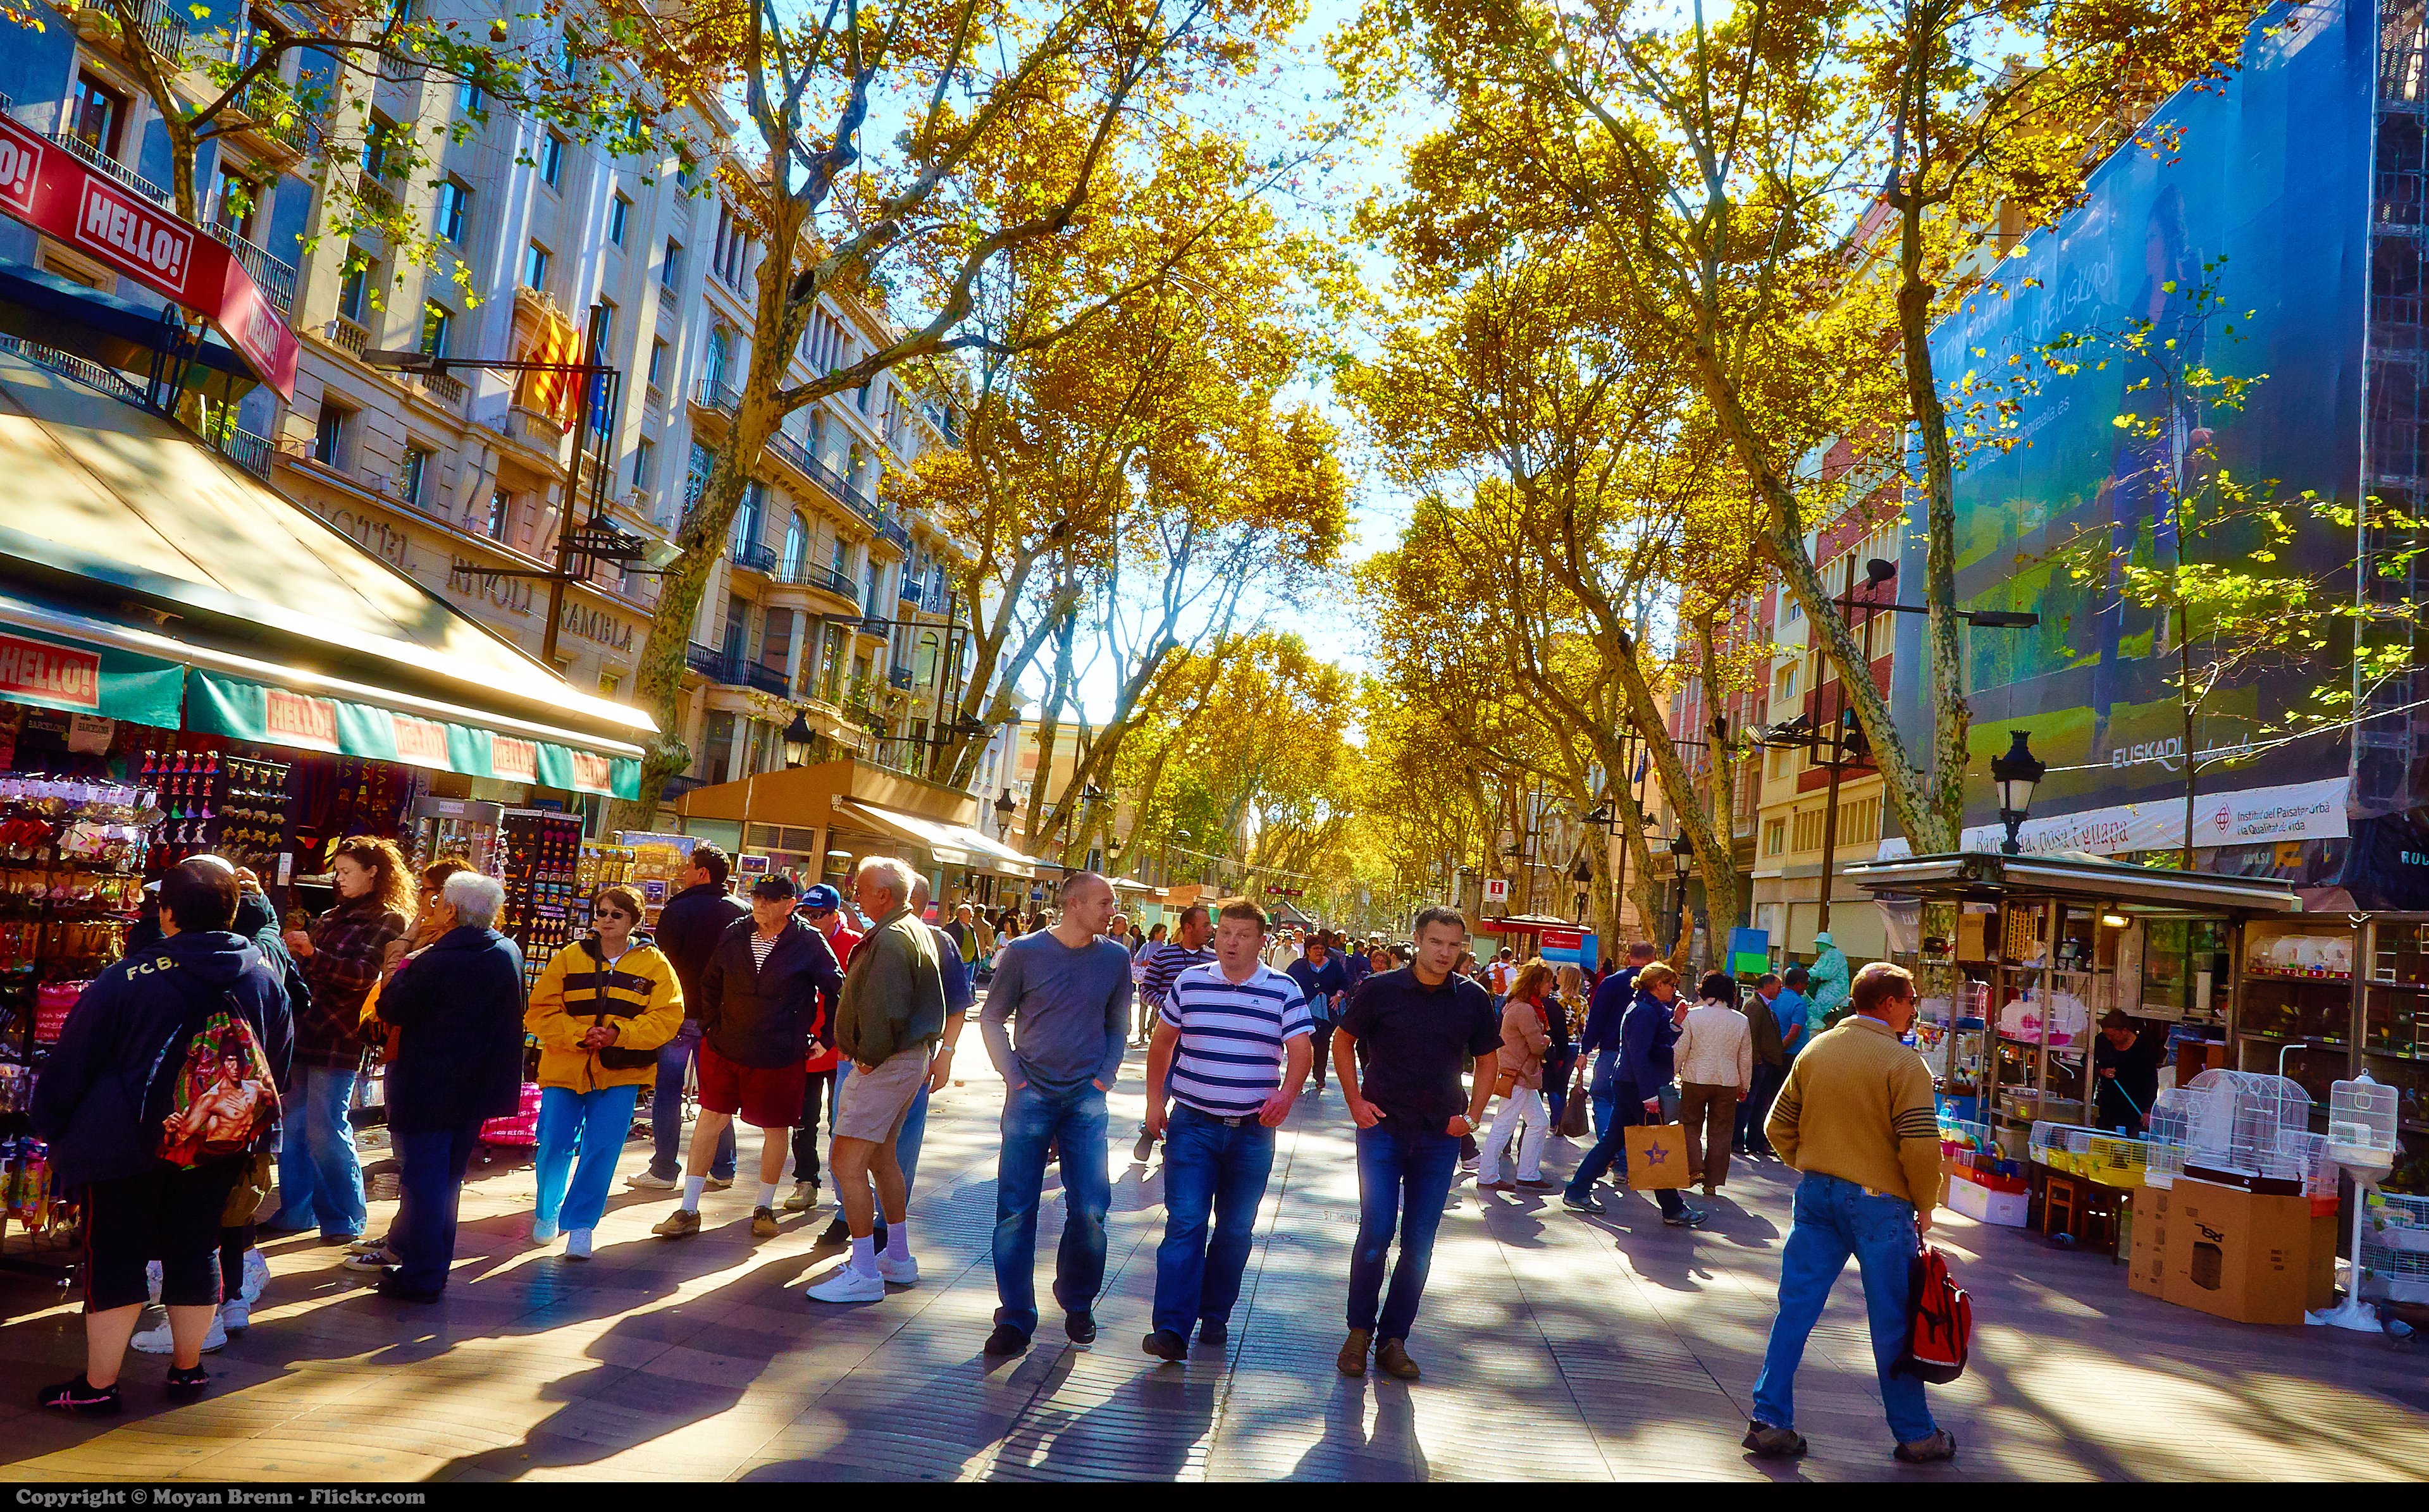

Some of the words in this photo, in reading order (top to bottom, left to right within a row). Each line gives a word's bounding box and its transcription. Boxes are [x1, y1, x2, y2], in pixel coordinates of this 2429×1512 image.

[87, 192, 183, 277] HELLO!
[248, 304, 277, 362] HELLO!
[0, 645, 91, 697] HELLO!
[271, 698, 332, 739] HELLO!
[396, 724, 444, 758] HELLO!
[493, 743, 534, 773] HELLO!
[575, 755, 608, 785] HELLO!
[2237, 809, 2264, 821] Institut
[2264, 808, 2275, 819] del
[2241, 826, 2248, 835] la
[2249, 823, 2278, 835] Qualitat
[2082, 820, 2129, 854] guapa
